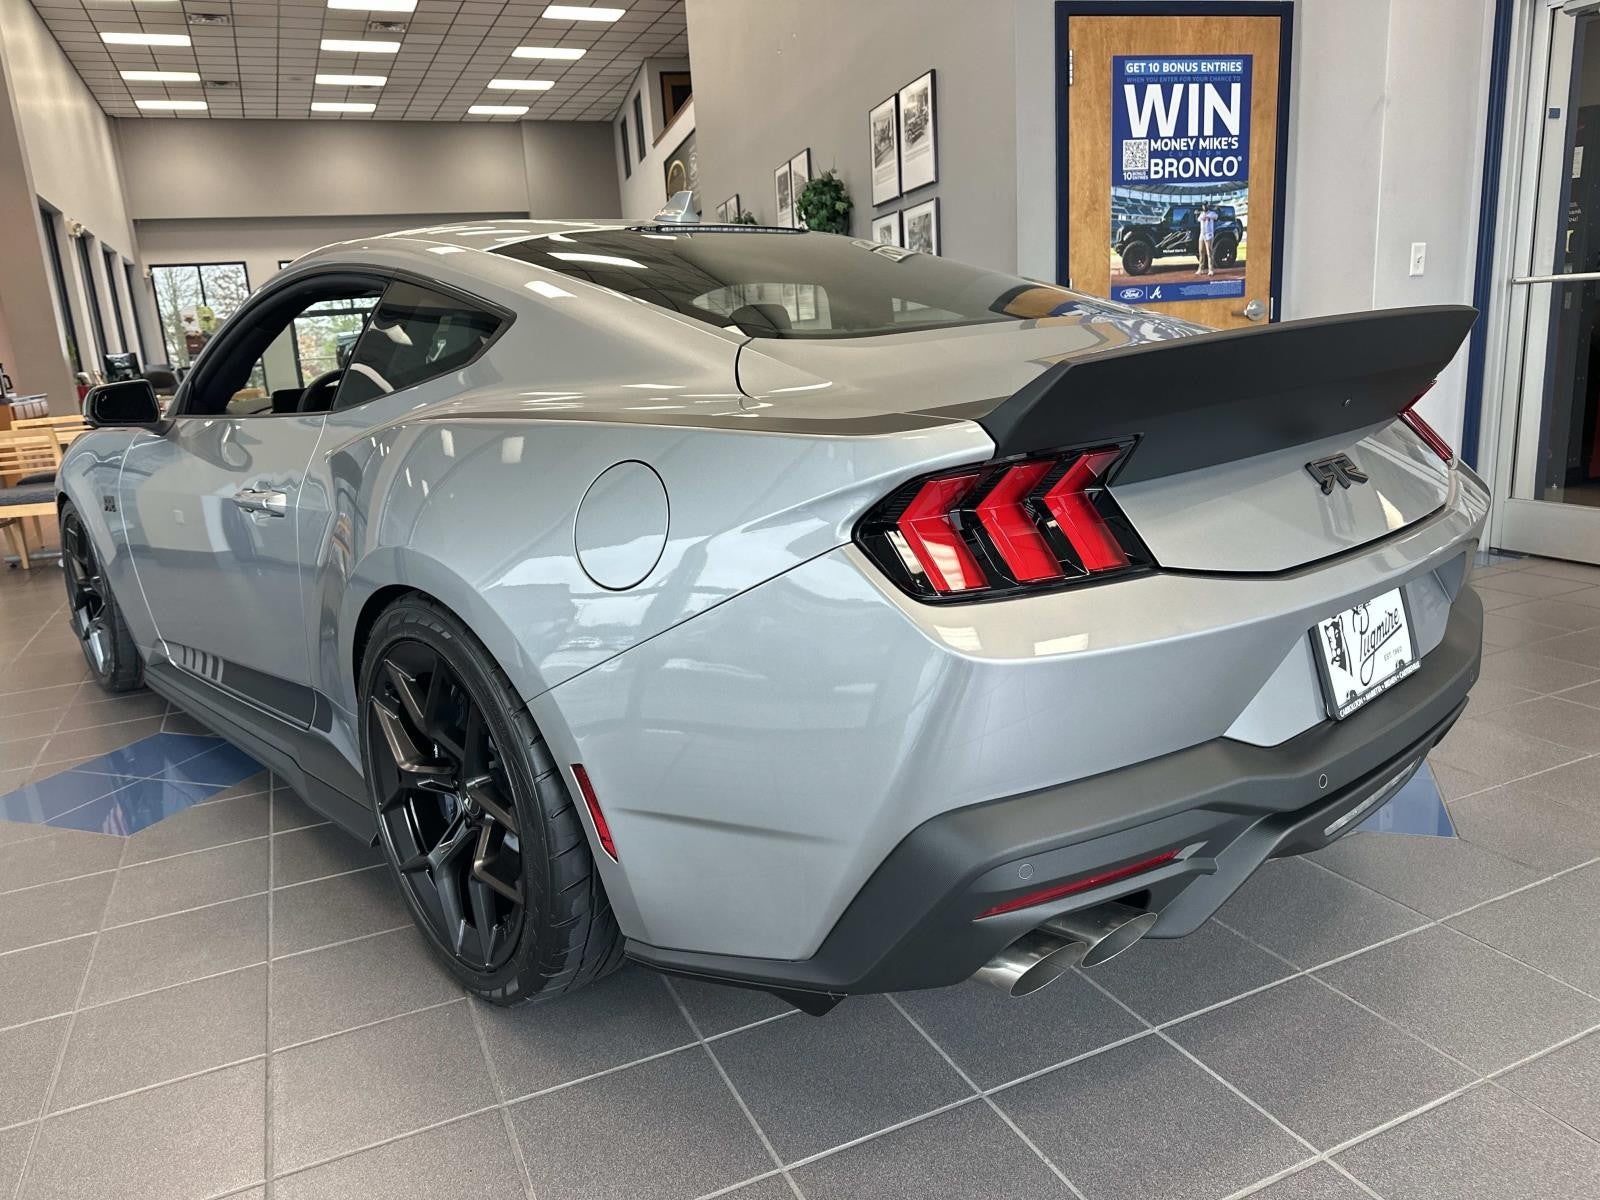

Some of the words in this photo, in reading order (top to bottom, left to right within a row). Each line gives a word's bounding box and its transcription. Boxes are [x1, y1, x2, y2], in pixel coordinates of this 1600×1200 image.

[1126, 63, 1146, 73] GET
[1148, 62, 1159, 73] 10
[1162, 62, 1198, 72] BONUS
[1201, 61, 1241, 72] ENTRIES
[1123, 82, 1241, 138] WIN
[1150, 138, 1197, 151] MONEY
[1199, 137, 1239, 150] MIKE'S
[1123, 172, 1132, 181] 10
[1124, 290, 1140, 298] Ford
[1352, 604, 1402, 686] Pugmire
